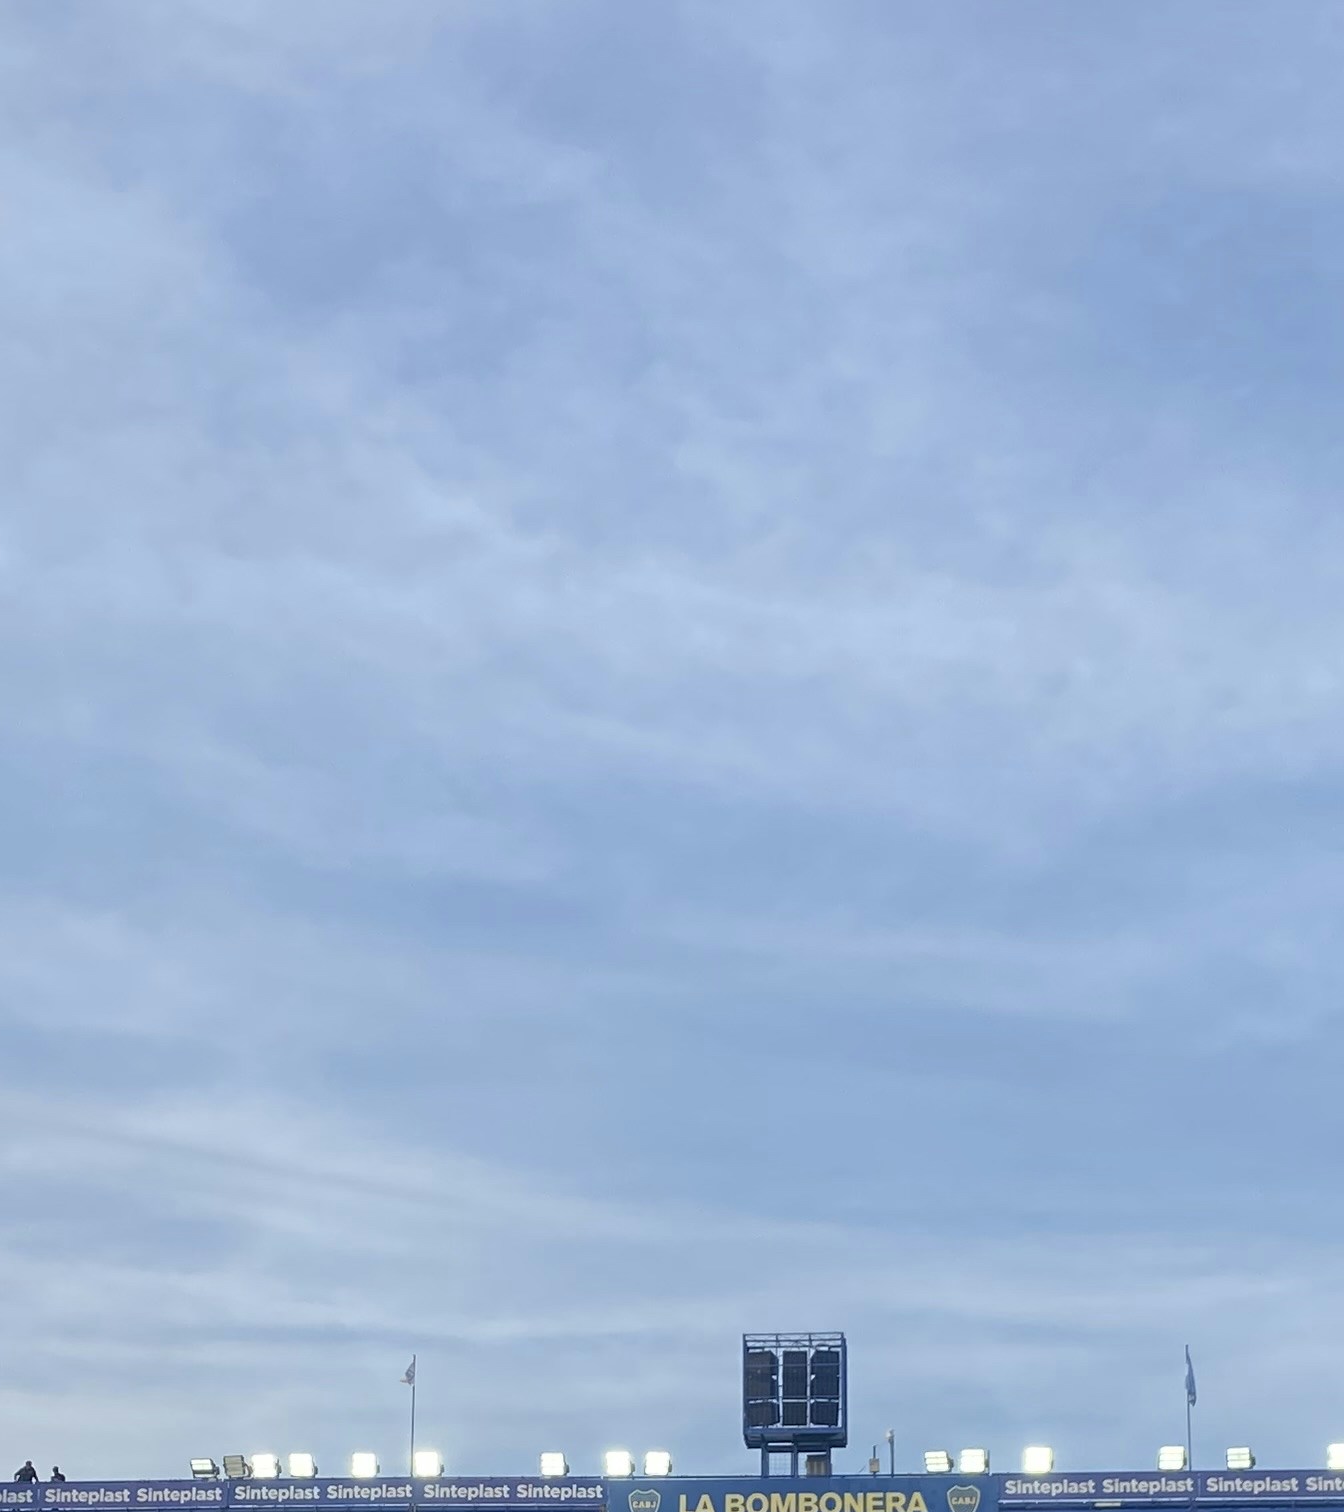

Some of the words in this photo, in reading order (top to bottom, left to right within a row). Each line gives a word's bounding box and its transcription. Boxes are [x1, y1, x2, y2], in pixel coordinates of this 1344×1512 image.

[45, 1488, 130, 1505] Sinteplast
[136, 1486, 222, 1504] Sinteplast
[234, 1485, 320, 1502] Sinteplast
[327, 1484, 413, 1501] Sinteplast
[423, 1484, 510, 1501] Sinteplast
[516, 1484, 603, 1501] Sinteplast
[1005, 1479, 1095, 1496] Sinteplast
[1102, 1477, 1194, 1494] Sinteplast
[1206, 1477, 1299, 1493] Sinteplast
